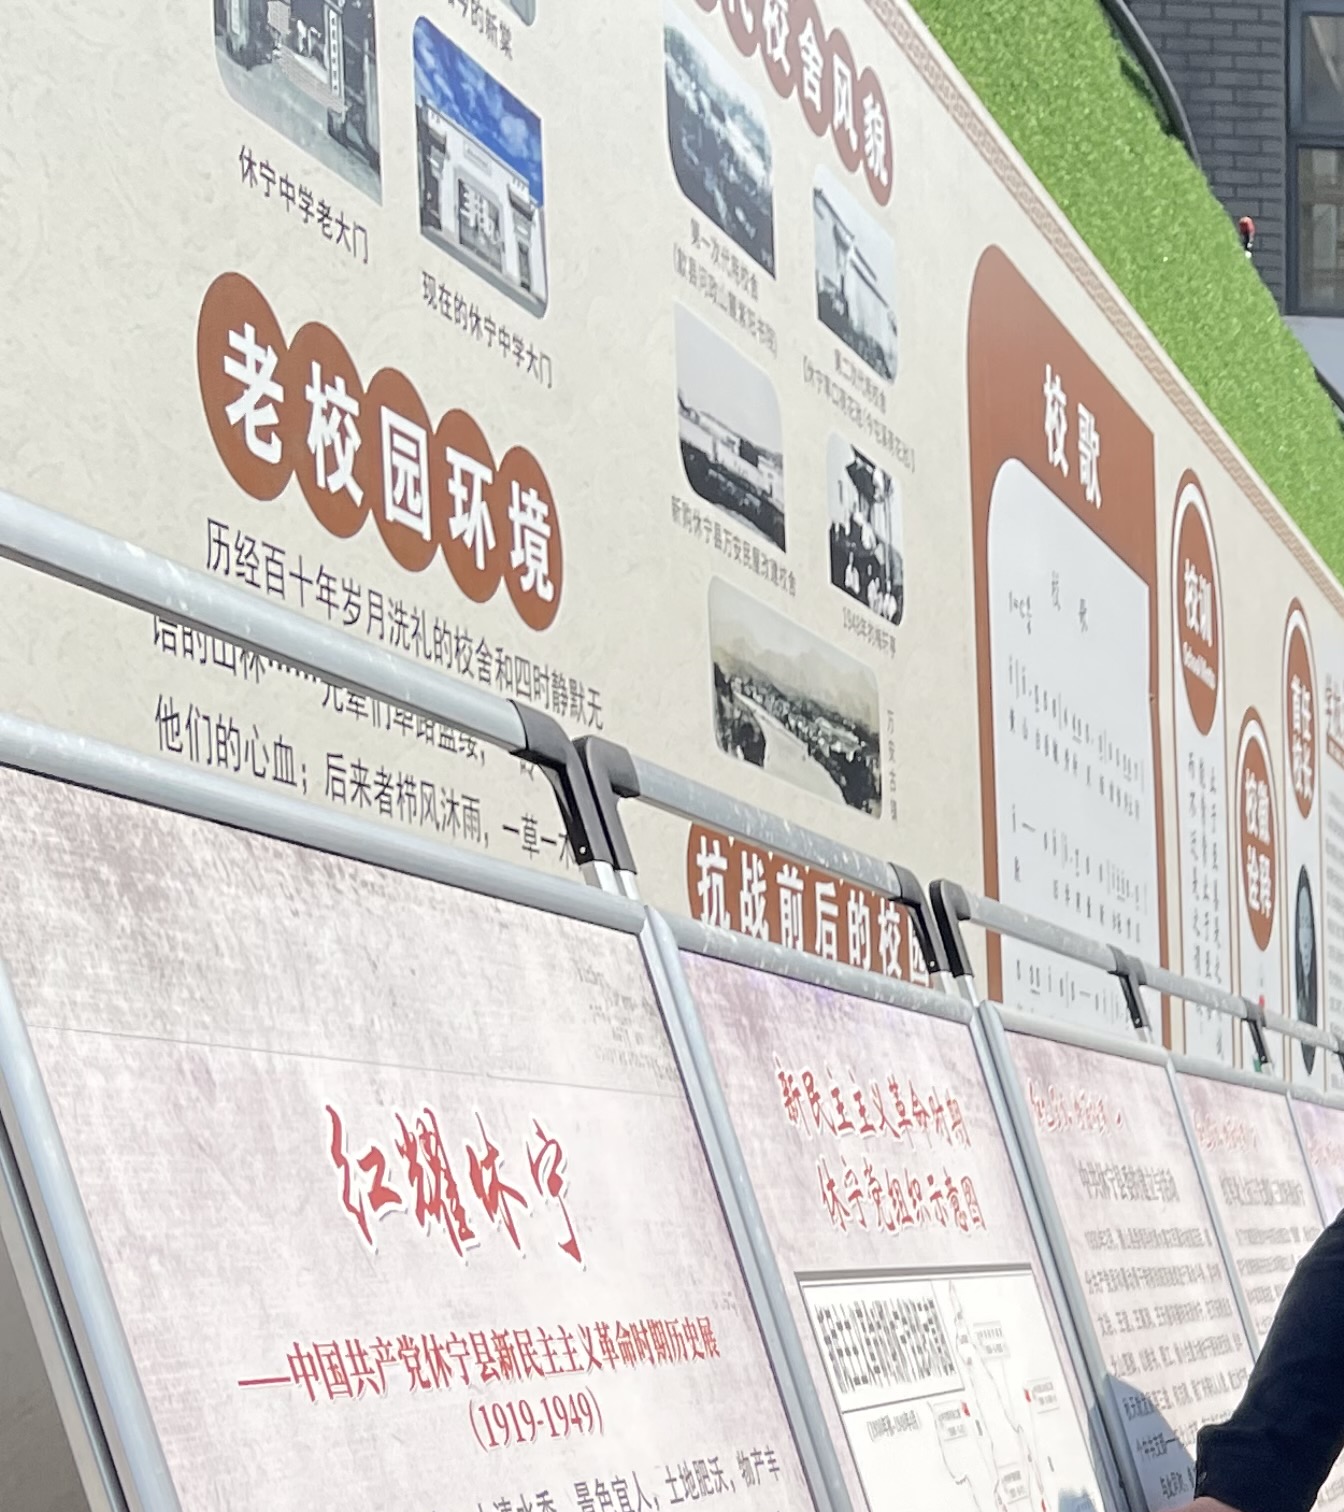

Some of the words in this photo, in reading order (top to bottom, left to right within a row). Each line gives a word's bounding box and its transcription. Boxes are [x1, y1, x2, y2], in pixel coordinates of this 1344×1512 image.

[238, 144, 369, 264] 休宁中学老大门
[420, 271, 554, 389] 现在的休宁中学大门
[223, 323, 556, 603] 老校园环境
[1044, 363, 1102, 509] 校歌
[206, 517, 604, 731] 历经百十年岁月洗礼的校舍和四时静默无
[776, 1052, 971, 1148] 新民主主义革命时期
[326, 1105, 584, 1261] 红耀休宁
[817, 1155, 987, 1234] 休宁党组织示意图
[468, 1388, 604, 1451] (1919-1949)
